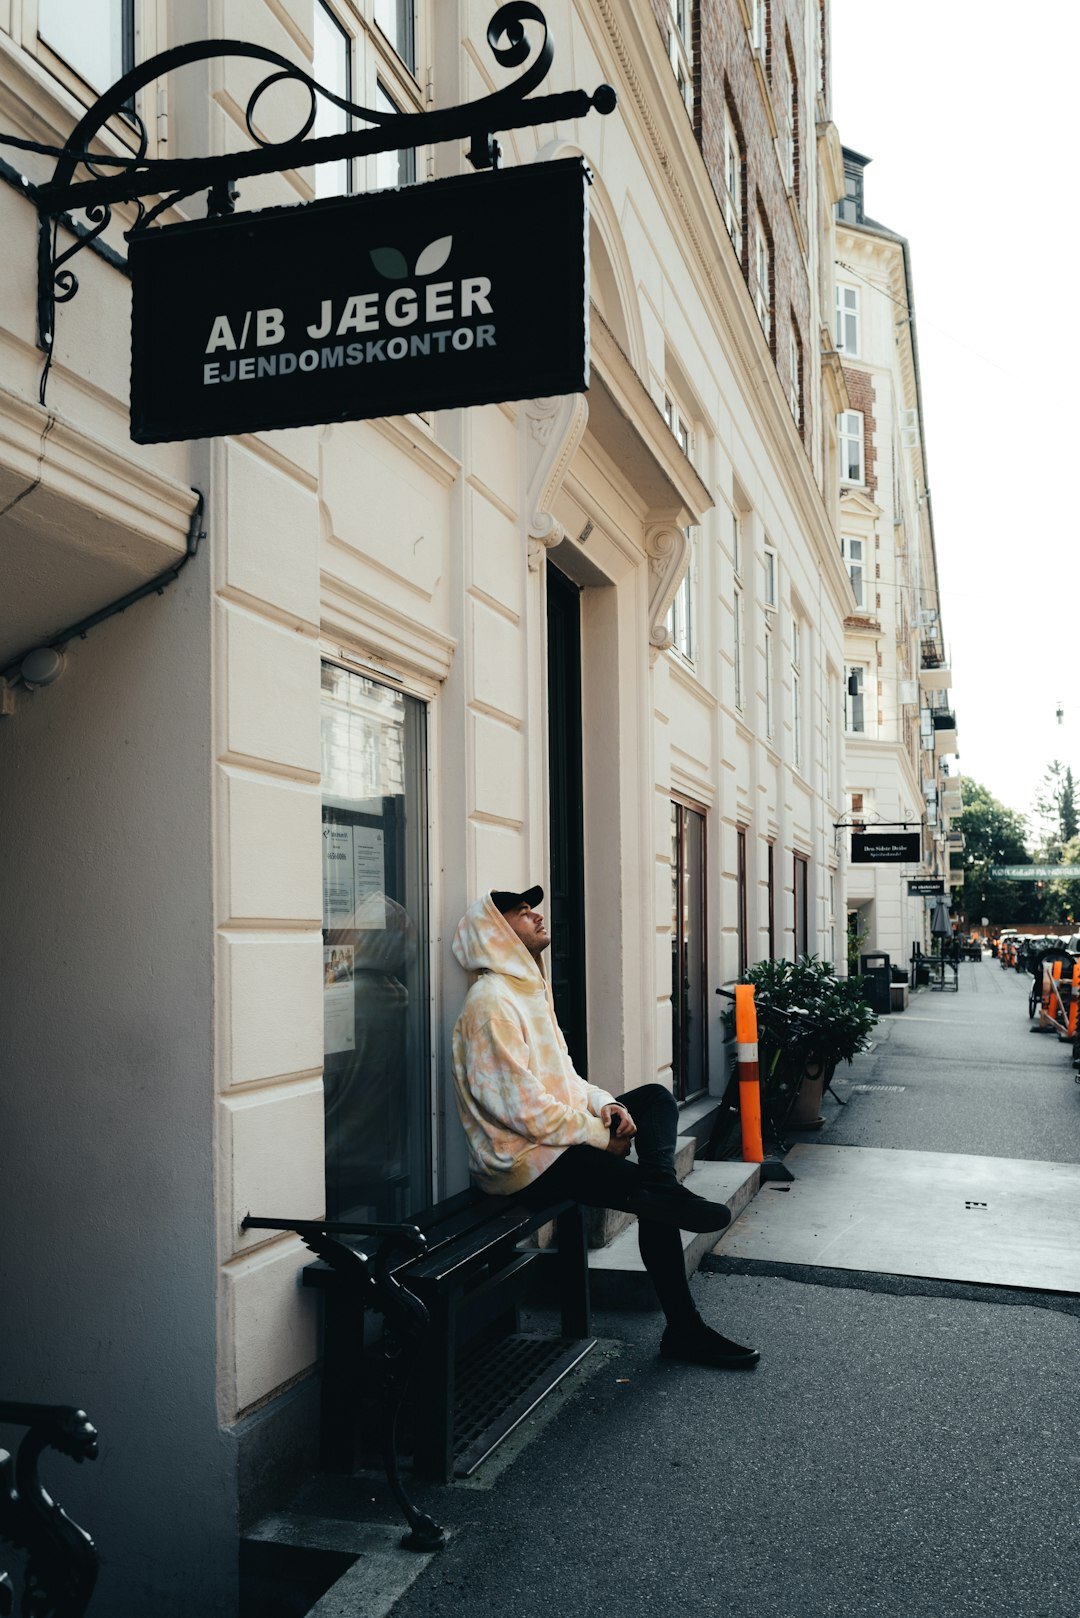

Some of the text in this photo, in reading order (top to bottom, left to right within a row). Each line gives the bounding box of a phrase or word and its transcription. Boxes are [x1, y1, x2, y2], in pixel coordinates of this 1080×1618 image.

[205, 276, 494, 354] A/B JÆGER
[203, 324, 497, 385] EJENDOMSKONTOR
